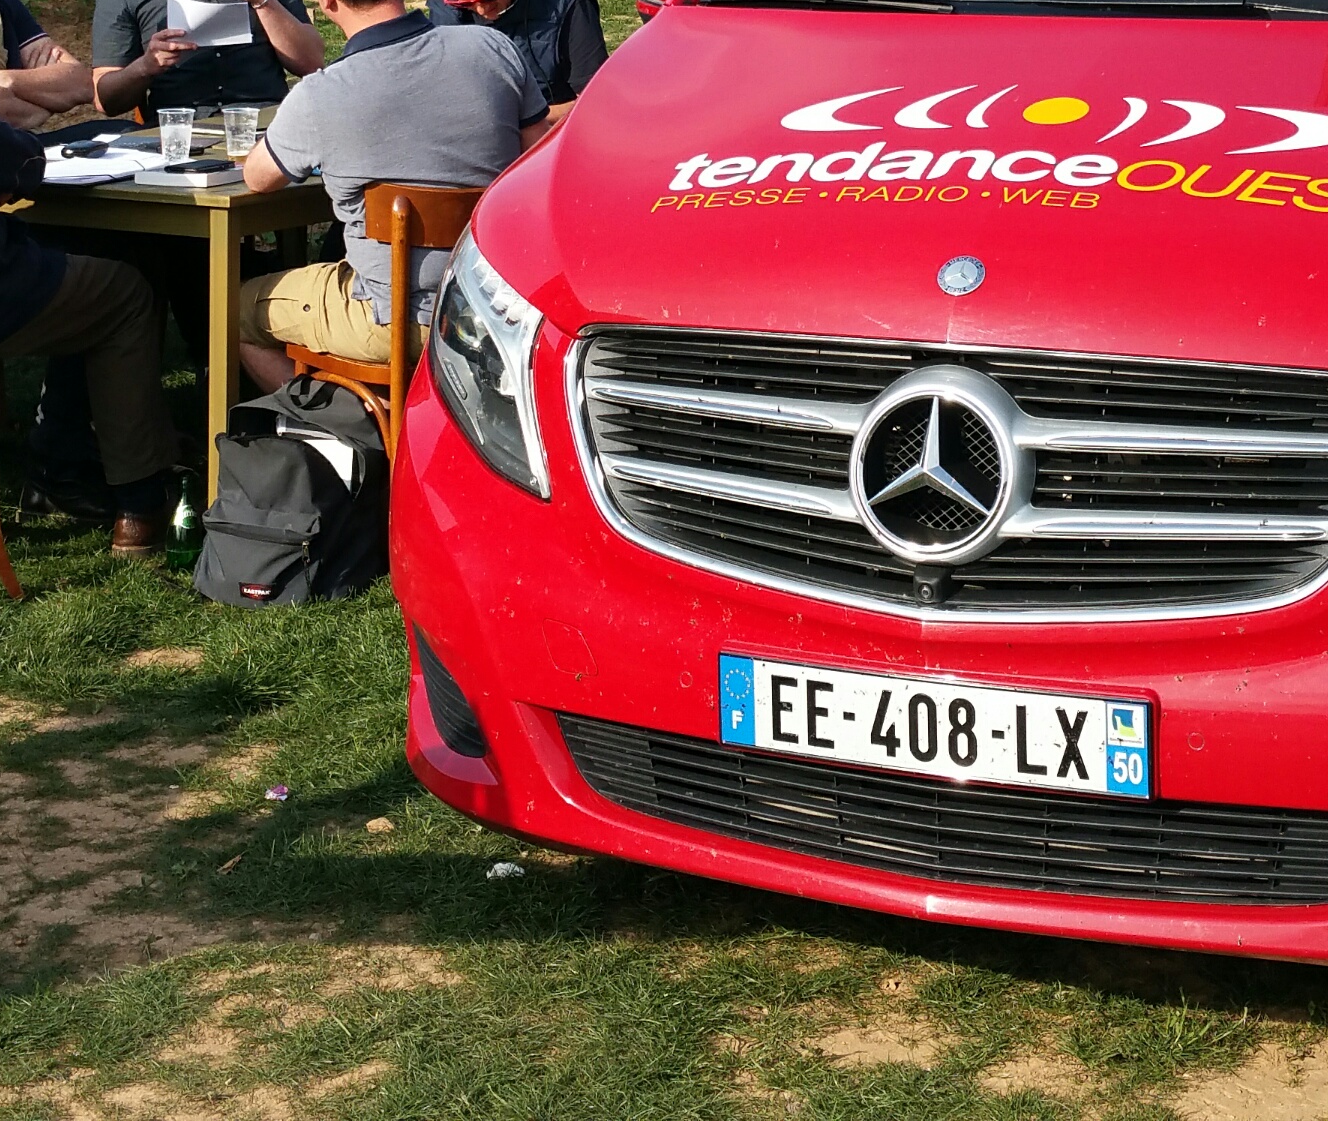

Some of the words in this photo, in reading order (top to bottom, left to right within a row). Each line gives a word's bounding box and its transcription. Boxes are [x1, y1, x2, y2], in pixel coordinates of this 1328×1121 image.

[651, 186, 811, 213] PRESSE
[835, 185, 970, 203] RADIO
[1000, 186, 1101, 210] WEB
[731, 709, 744, 730] F
[770, 673, 1090, 781] EE-408-LX
[1112, 752, 1144, 786] 50
